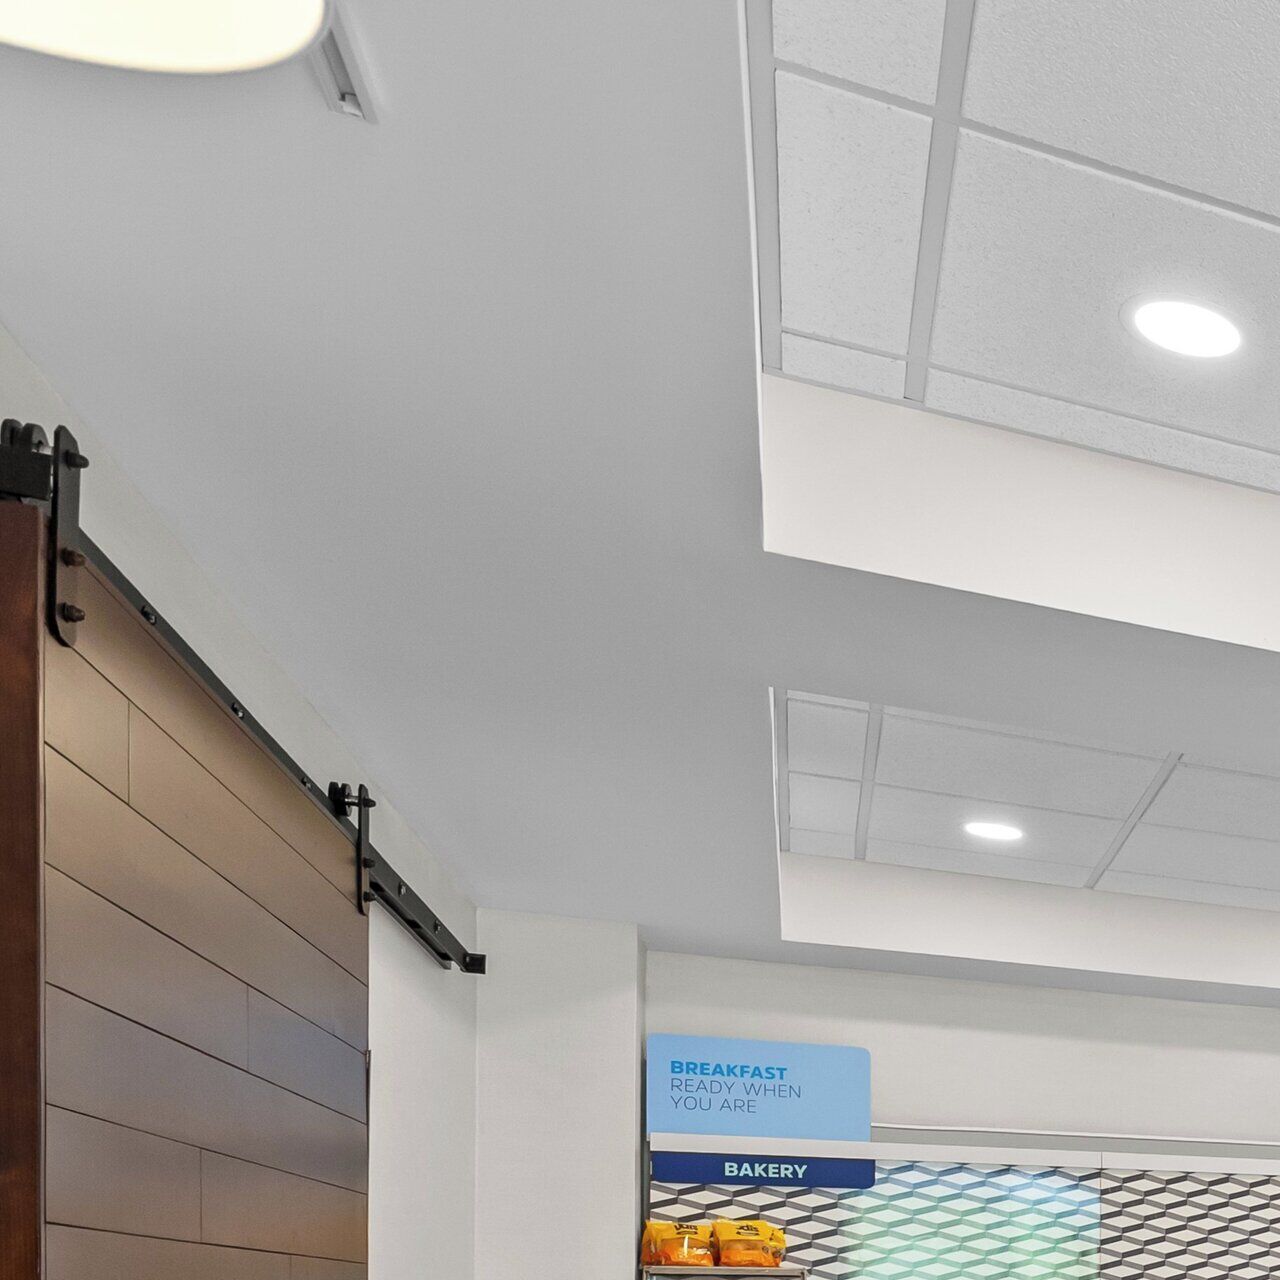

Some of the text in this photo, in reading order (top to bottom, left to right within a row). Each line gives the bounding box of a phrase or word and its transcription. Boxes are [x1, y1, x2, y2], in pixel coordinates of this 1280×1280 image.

[670, 1060, 788, 1080] BREAKFAST
[671, 1078, 801, 1098] READY WHEN
[670, 1095, 757, 1113] YOU ARE
[724, 1162, 808, 1178] BAKERY
